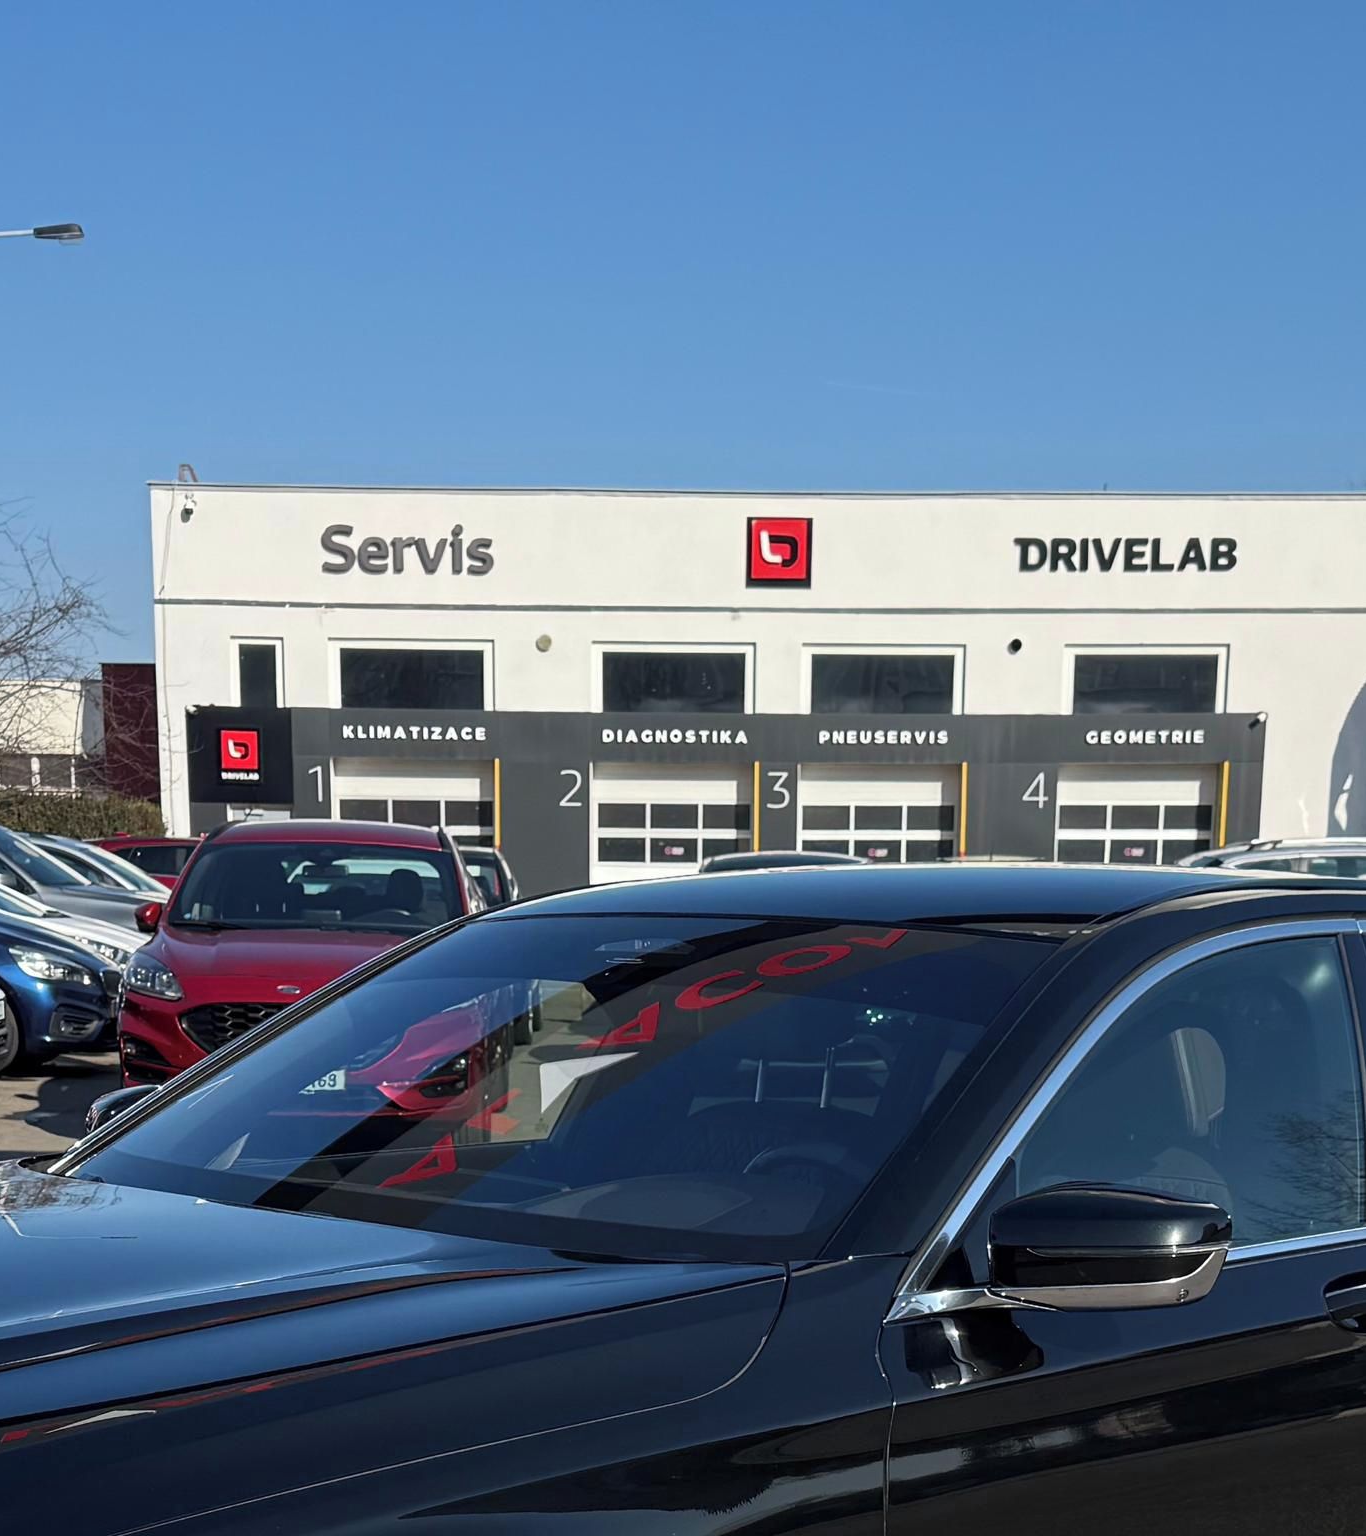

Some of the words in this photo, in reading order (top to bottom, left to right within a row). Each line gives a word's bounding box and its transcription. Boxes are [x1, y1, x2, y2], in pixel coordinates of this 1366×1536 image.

[321, 524, 494, 575] Servis
[1013, 537, 1238, 573] DRIVELAB
[341, 724, 487, 742] KLIMATIZACE
[601, 728, 749, 745] DIAGNOSTIKA
[818, 729, 950, 746] PNEUSERVIS
[1085, 729, 1206, 745] GEOMETRIE
[307, 765, 324, 803] 1
[558, 769, 583, 807] 2
[766, 771, 791, 809] 3
[1021, 772, 1049, 809] 4
